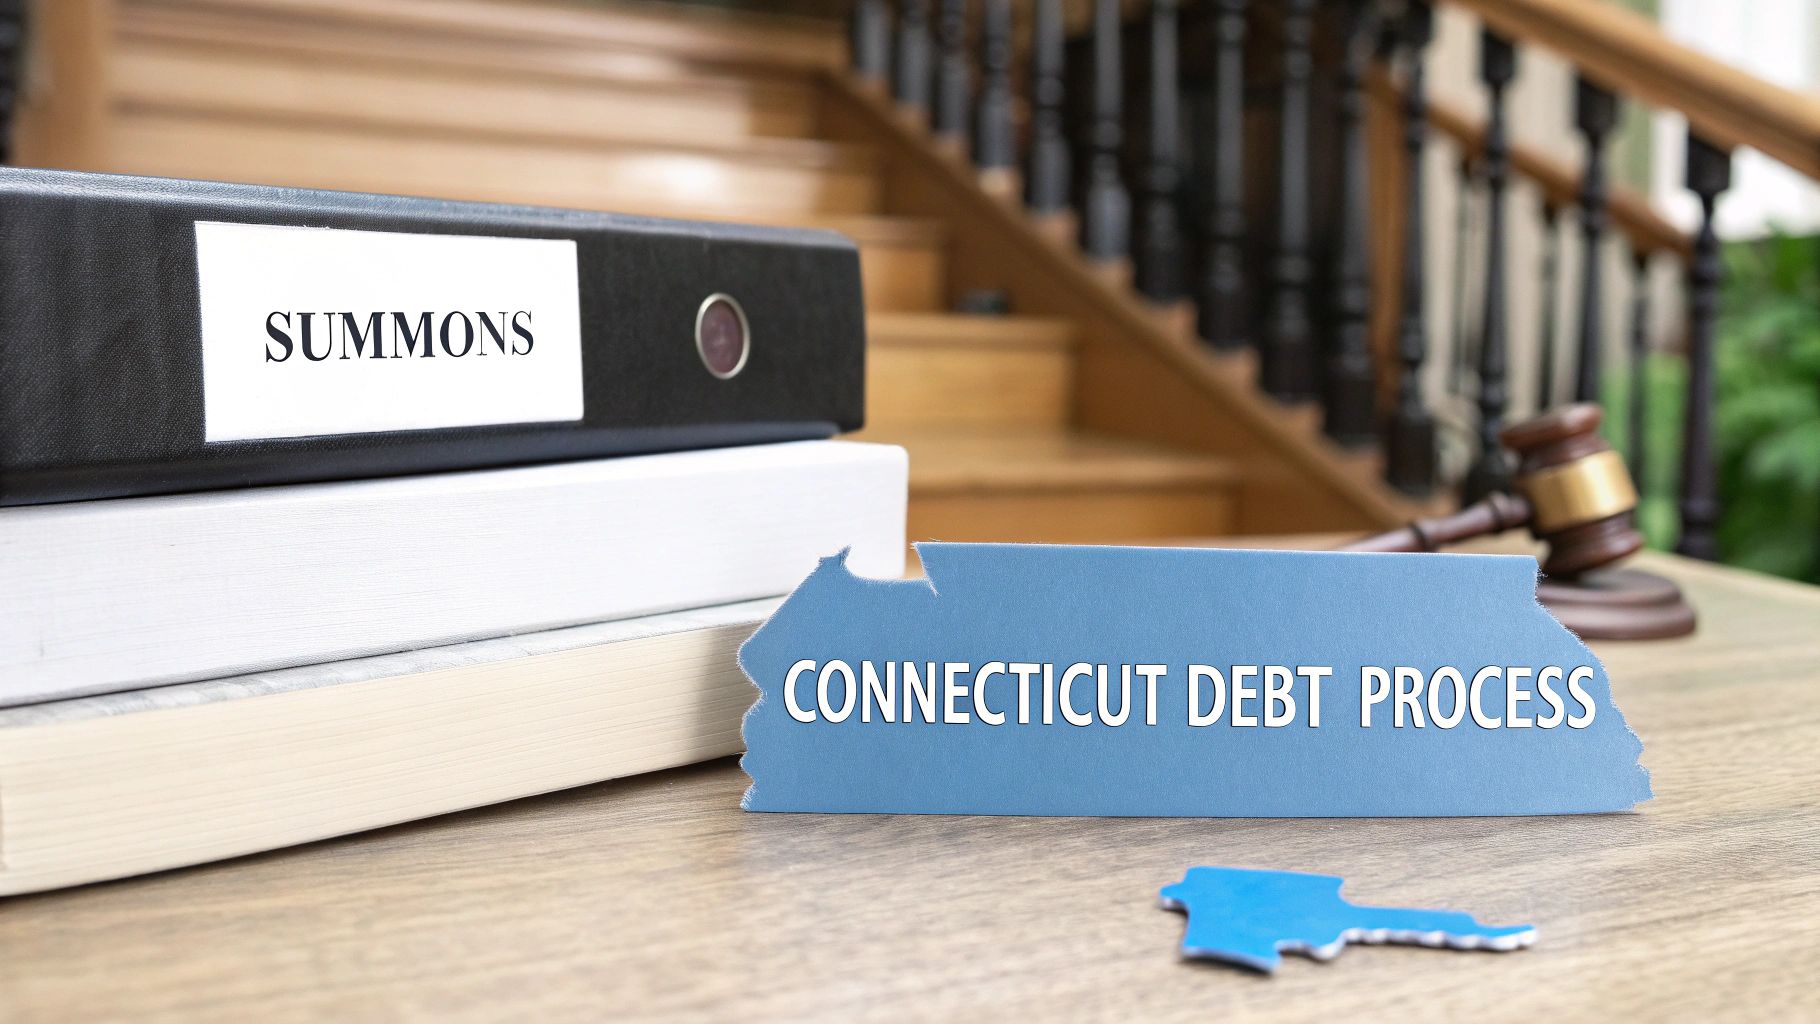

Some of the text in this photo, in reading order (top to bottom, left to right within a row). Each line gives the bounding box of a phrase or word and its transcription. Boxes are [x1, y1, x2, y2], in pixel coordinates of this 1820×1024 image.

[265, 310, 534, 363] SUMMONS
[784, 659, 1597, 730] CONNECTICUT DEBT PROCESS
